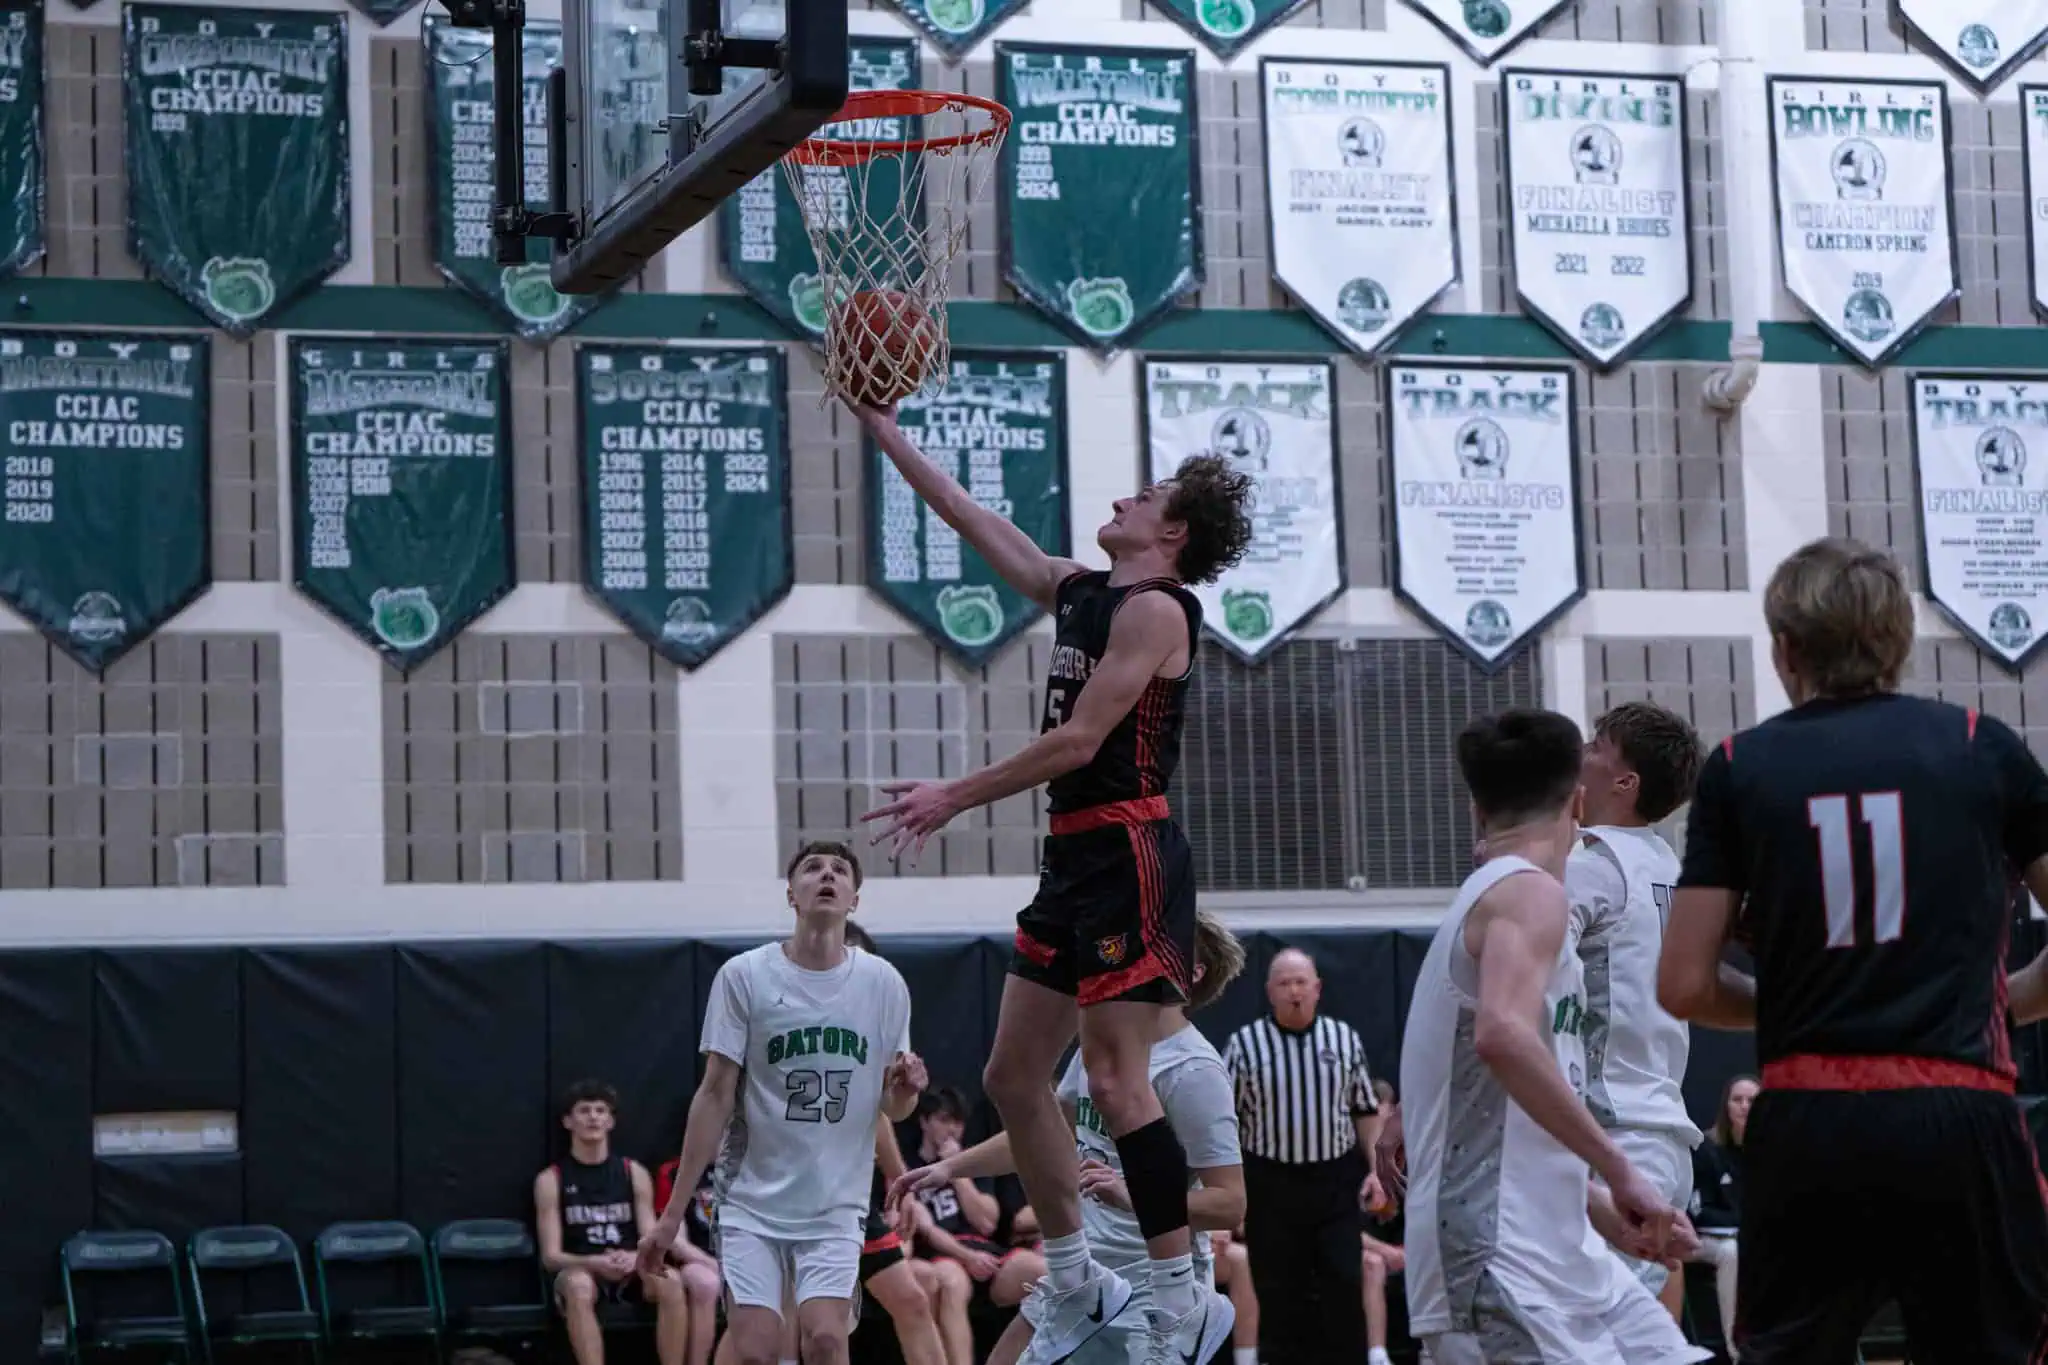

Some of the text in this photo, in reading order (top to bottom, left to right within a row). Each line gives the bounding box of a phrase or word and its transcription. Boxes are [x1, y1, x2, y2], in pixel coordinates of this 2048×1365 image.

[193, 68, 281, 92] CCIAC
[151, 88, 323, 117] CHAMPIONS
[1058, 103, 1137, 125] CCIAC
[1020, 122, 1176, 146] CHAMPIONS
[1783, 105, 1935, 141] BOWLING
[55, 394, 140, 421] CCIAC
[643, 400, 721, 424] CCIAC
[925, 407, 1005, 427] CCIAC
[1401, 387, 1562, 425] TRACK
[1923, 398, 2048, 430] TRAC
[9, 420, 184, 449] CHAMPIONS
[356, 412, 446, 434] CCIAC
[306, 432, 495, 456] CHAMPIONS
[601, 426, 764, 451] CHAMPIONS
[899, 426, 1046, 450] HAMPIONS
[5, 456, 54, 476] 2018
[661, 453, 706, 471] 2014
[724, 453, 769, 471] 2022
[5, 479, 54, 500] 2019
[662, 473, 707, 491] 2015
[725, 472, 769, 492] 2024
[5, 501, 54, 523] 2020
[663, 492, 707, 510] 2017
[1807, 789, 1906, 949] 11
[785, 1069, 853, 1123] 25
